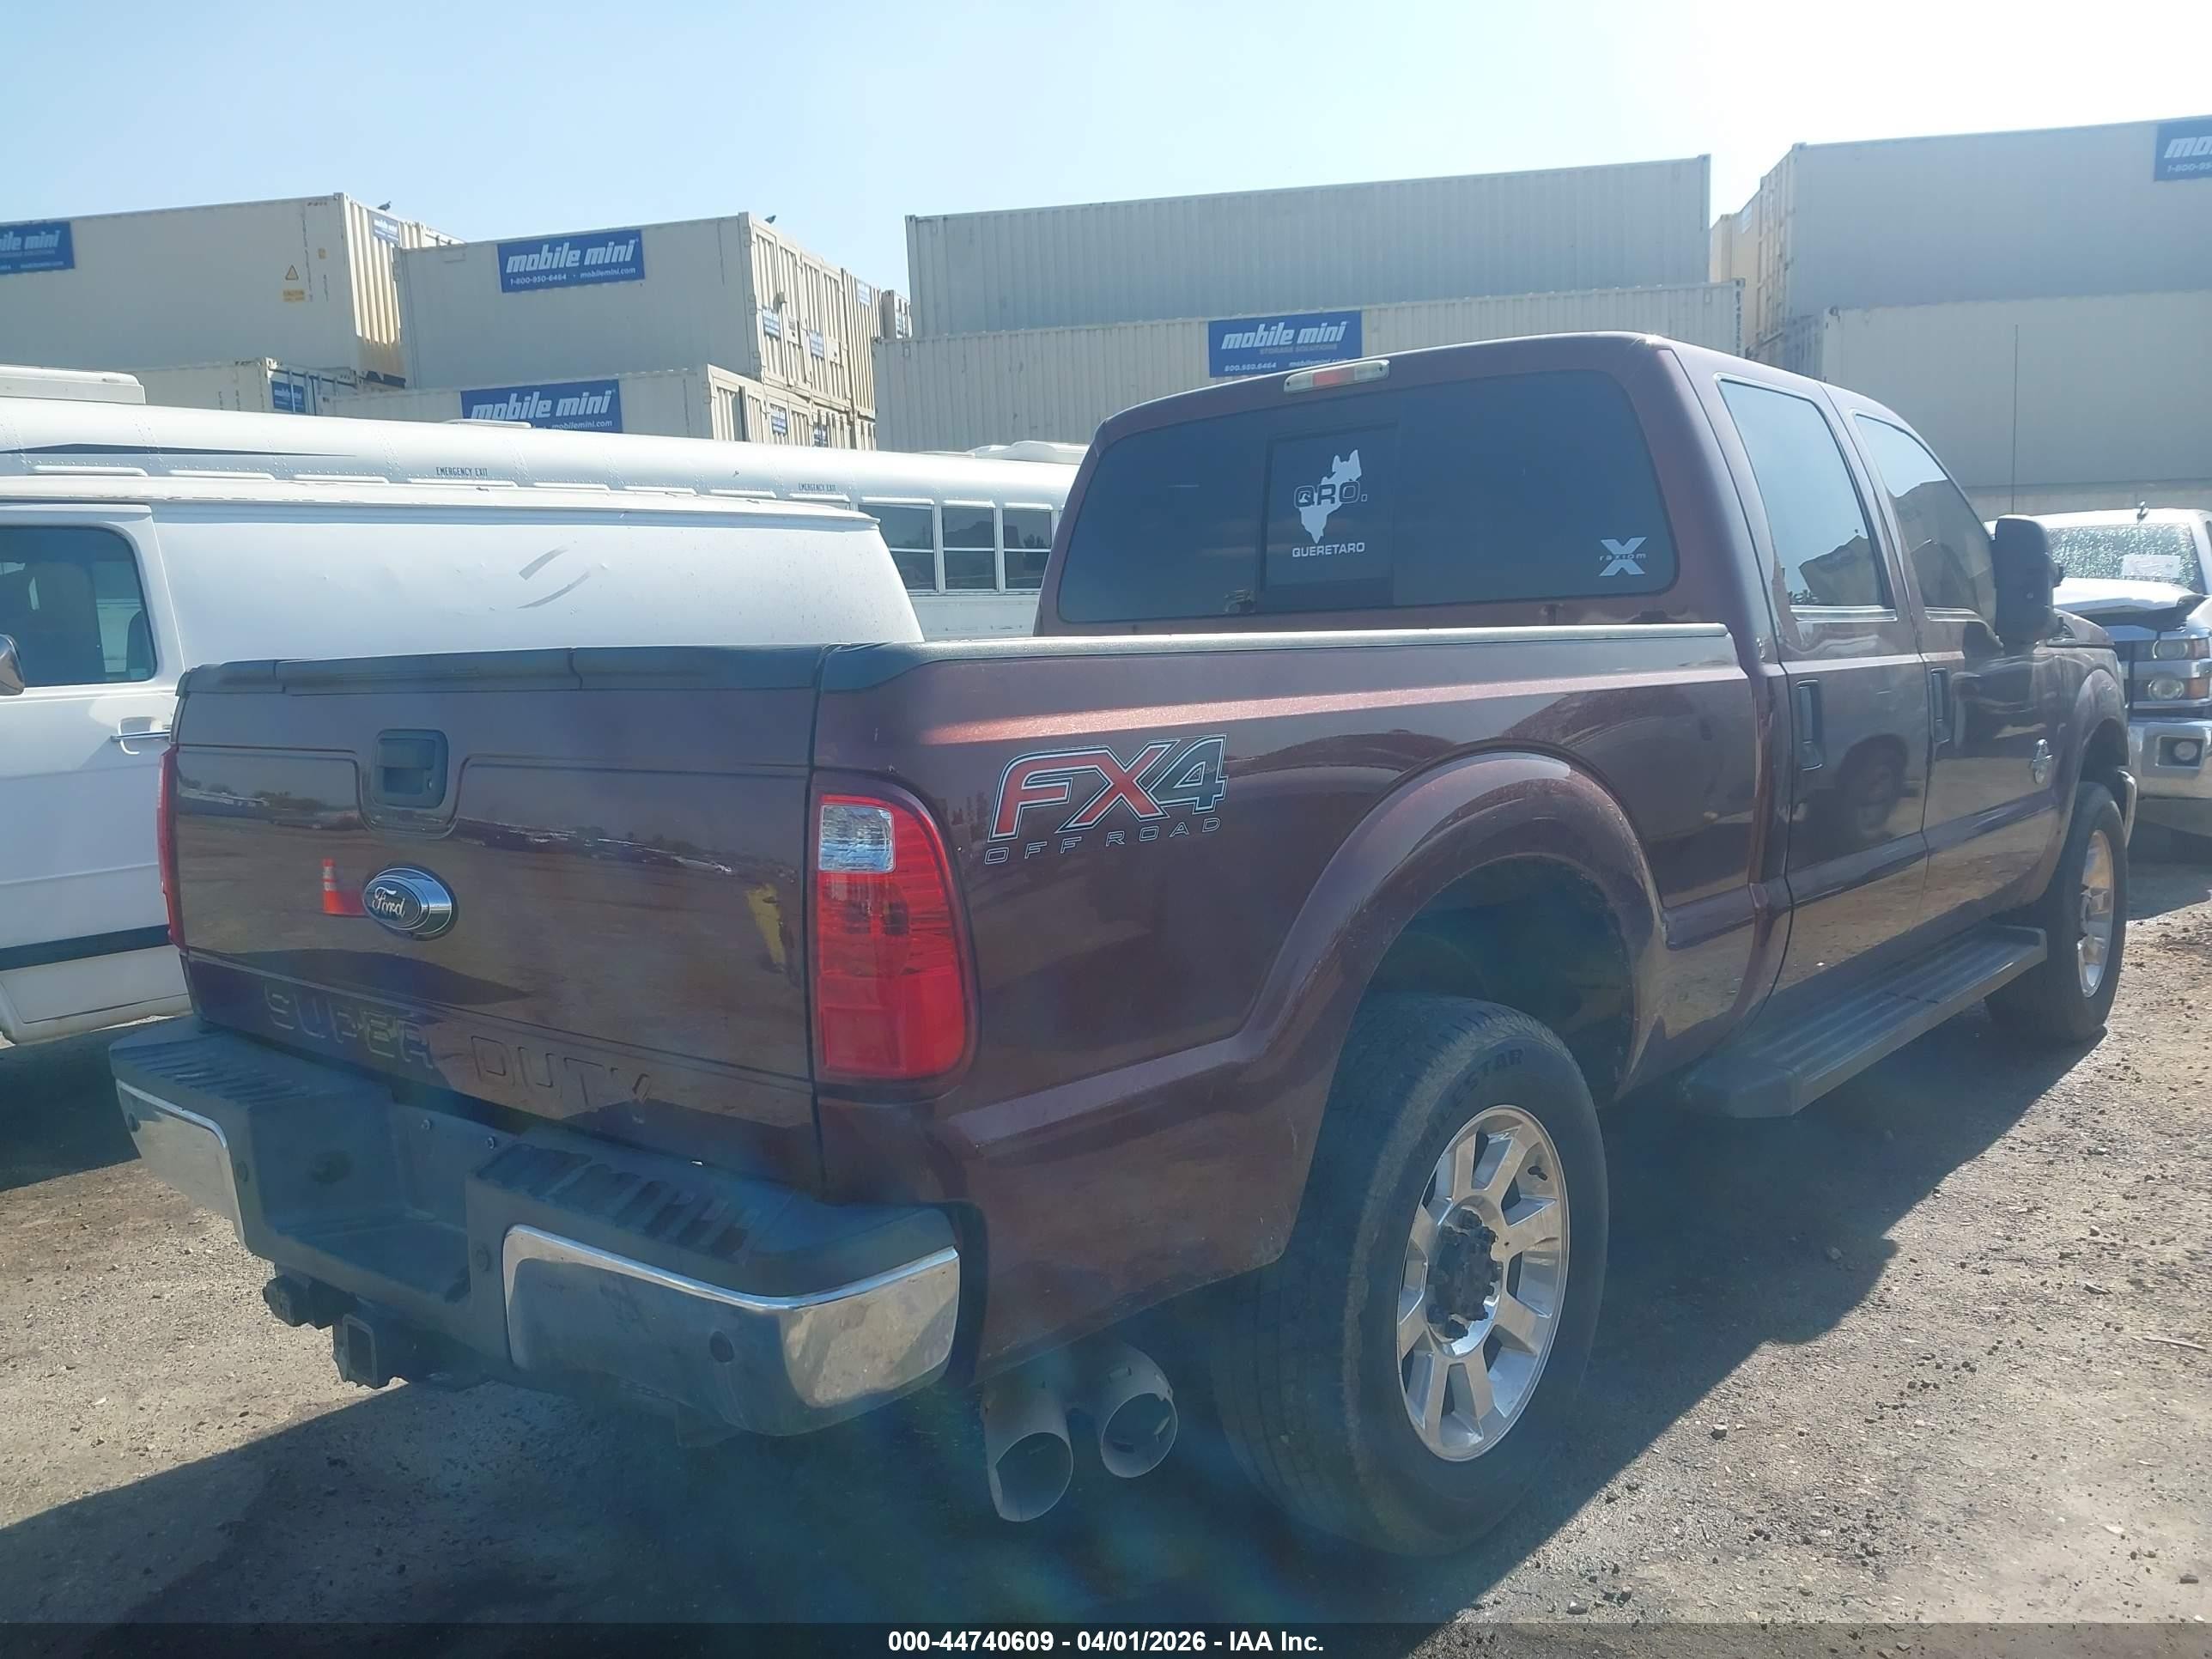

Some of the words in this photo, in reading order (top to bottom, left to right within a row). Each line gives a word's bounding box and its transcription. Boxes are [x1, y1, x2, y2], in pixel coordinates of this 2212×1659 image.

[2164, 136, 2212, 159] mo
[24, 229, 61, 250] mini
[506, 242, 581, 274] mobile
[584, 240, 635, 266] mini
[580, 267, 636, 279] mobilemini.com
[1221, 322, 1295, 349] mobile
[1297, 321, 1347, 344] mini
[471, 392, 552, 420] mobile
[556, 390, 611, 417] mini
[436, 466, 472, 477] EMERGENCY
[475, 467, 488, 477] EXIT
[1291, 542, 1365, 557] QUERETARO
[988, 734, 1229, 842] FX4
[984, 836, 1083, 866] OFF
[1105, 817, 1222, 848] ROAD
[371, 886, 405, 918] Ford
[264, 981, 434, 1070] SUPER
[470, 1034, 652, 1125] DUTY
